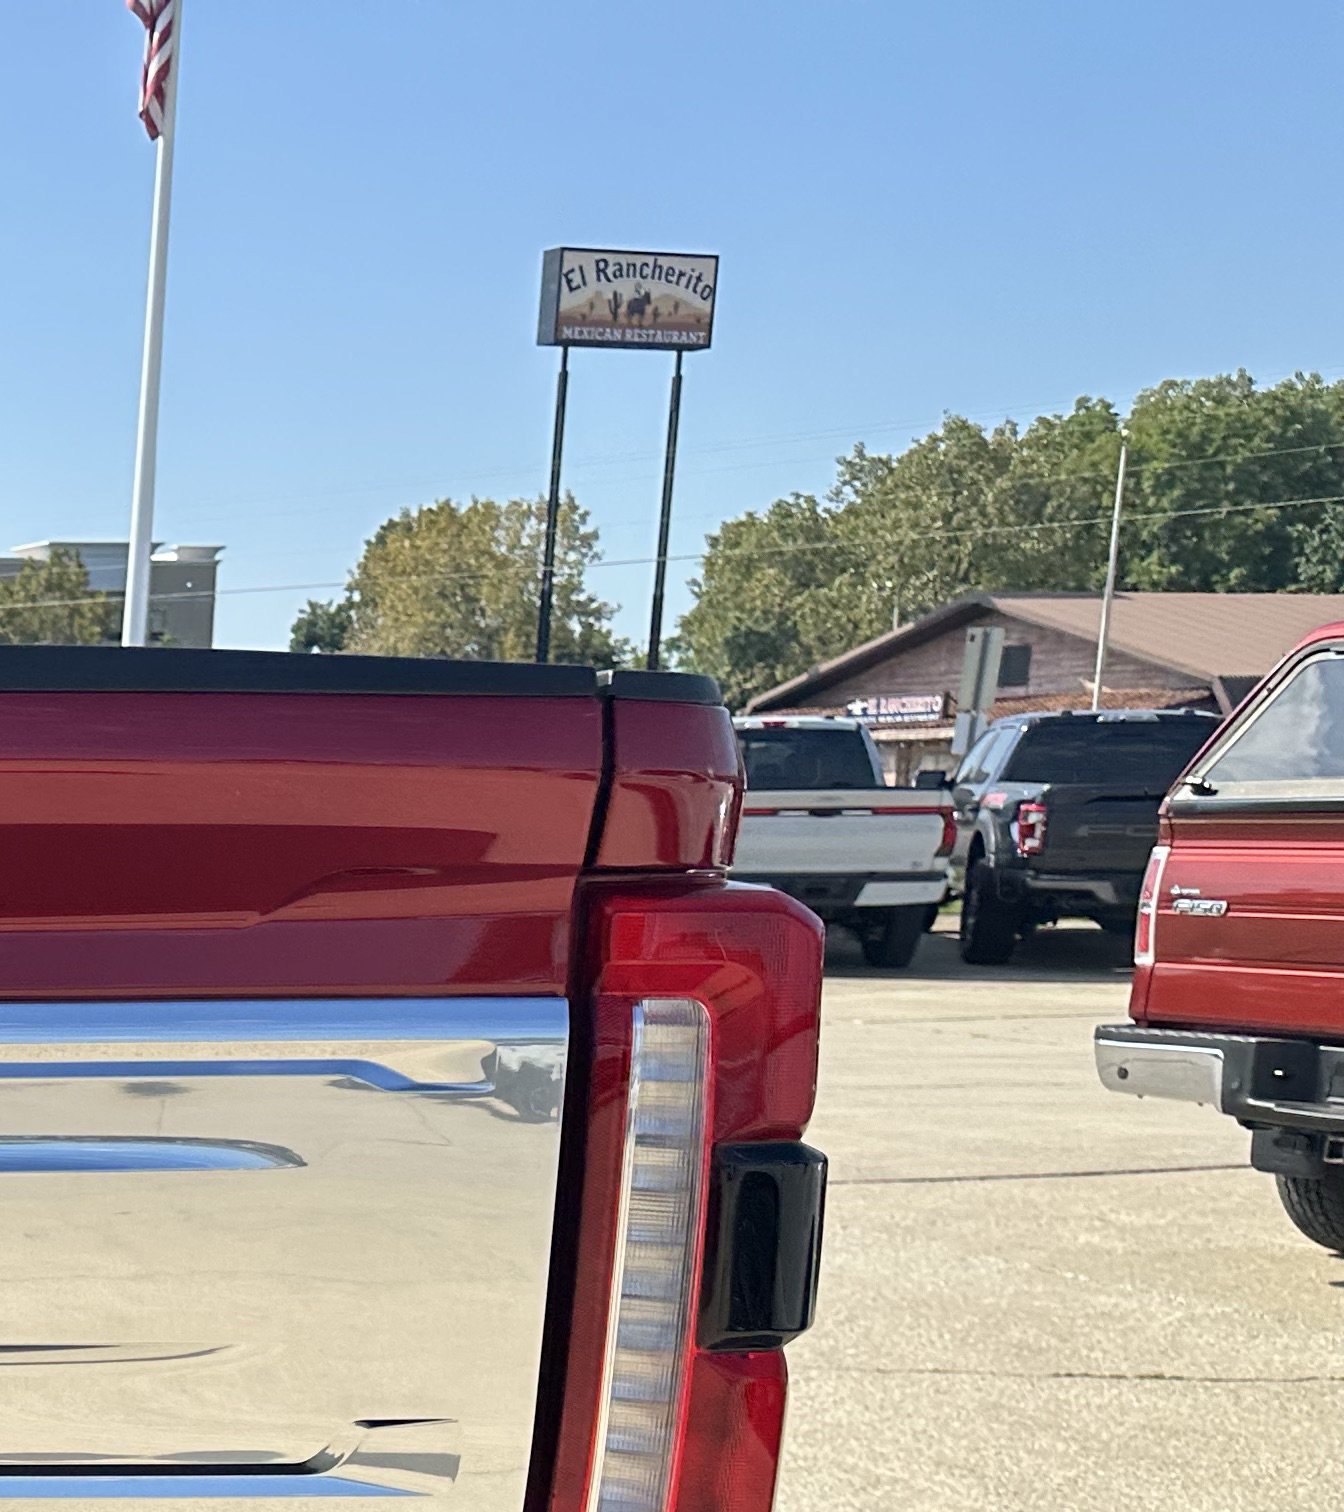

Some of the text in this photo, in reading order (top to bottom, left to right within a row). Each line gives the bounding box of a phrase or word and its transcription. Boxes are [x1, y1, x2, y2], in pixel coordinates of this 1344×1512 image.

[562, 258, 713, 301] El Rancherito
[561, 326, 707, 345] MEXICAN RESTAURANT
